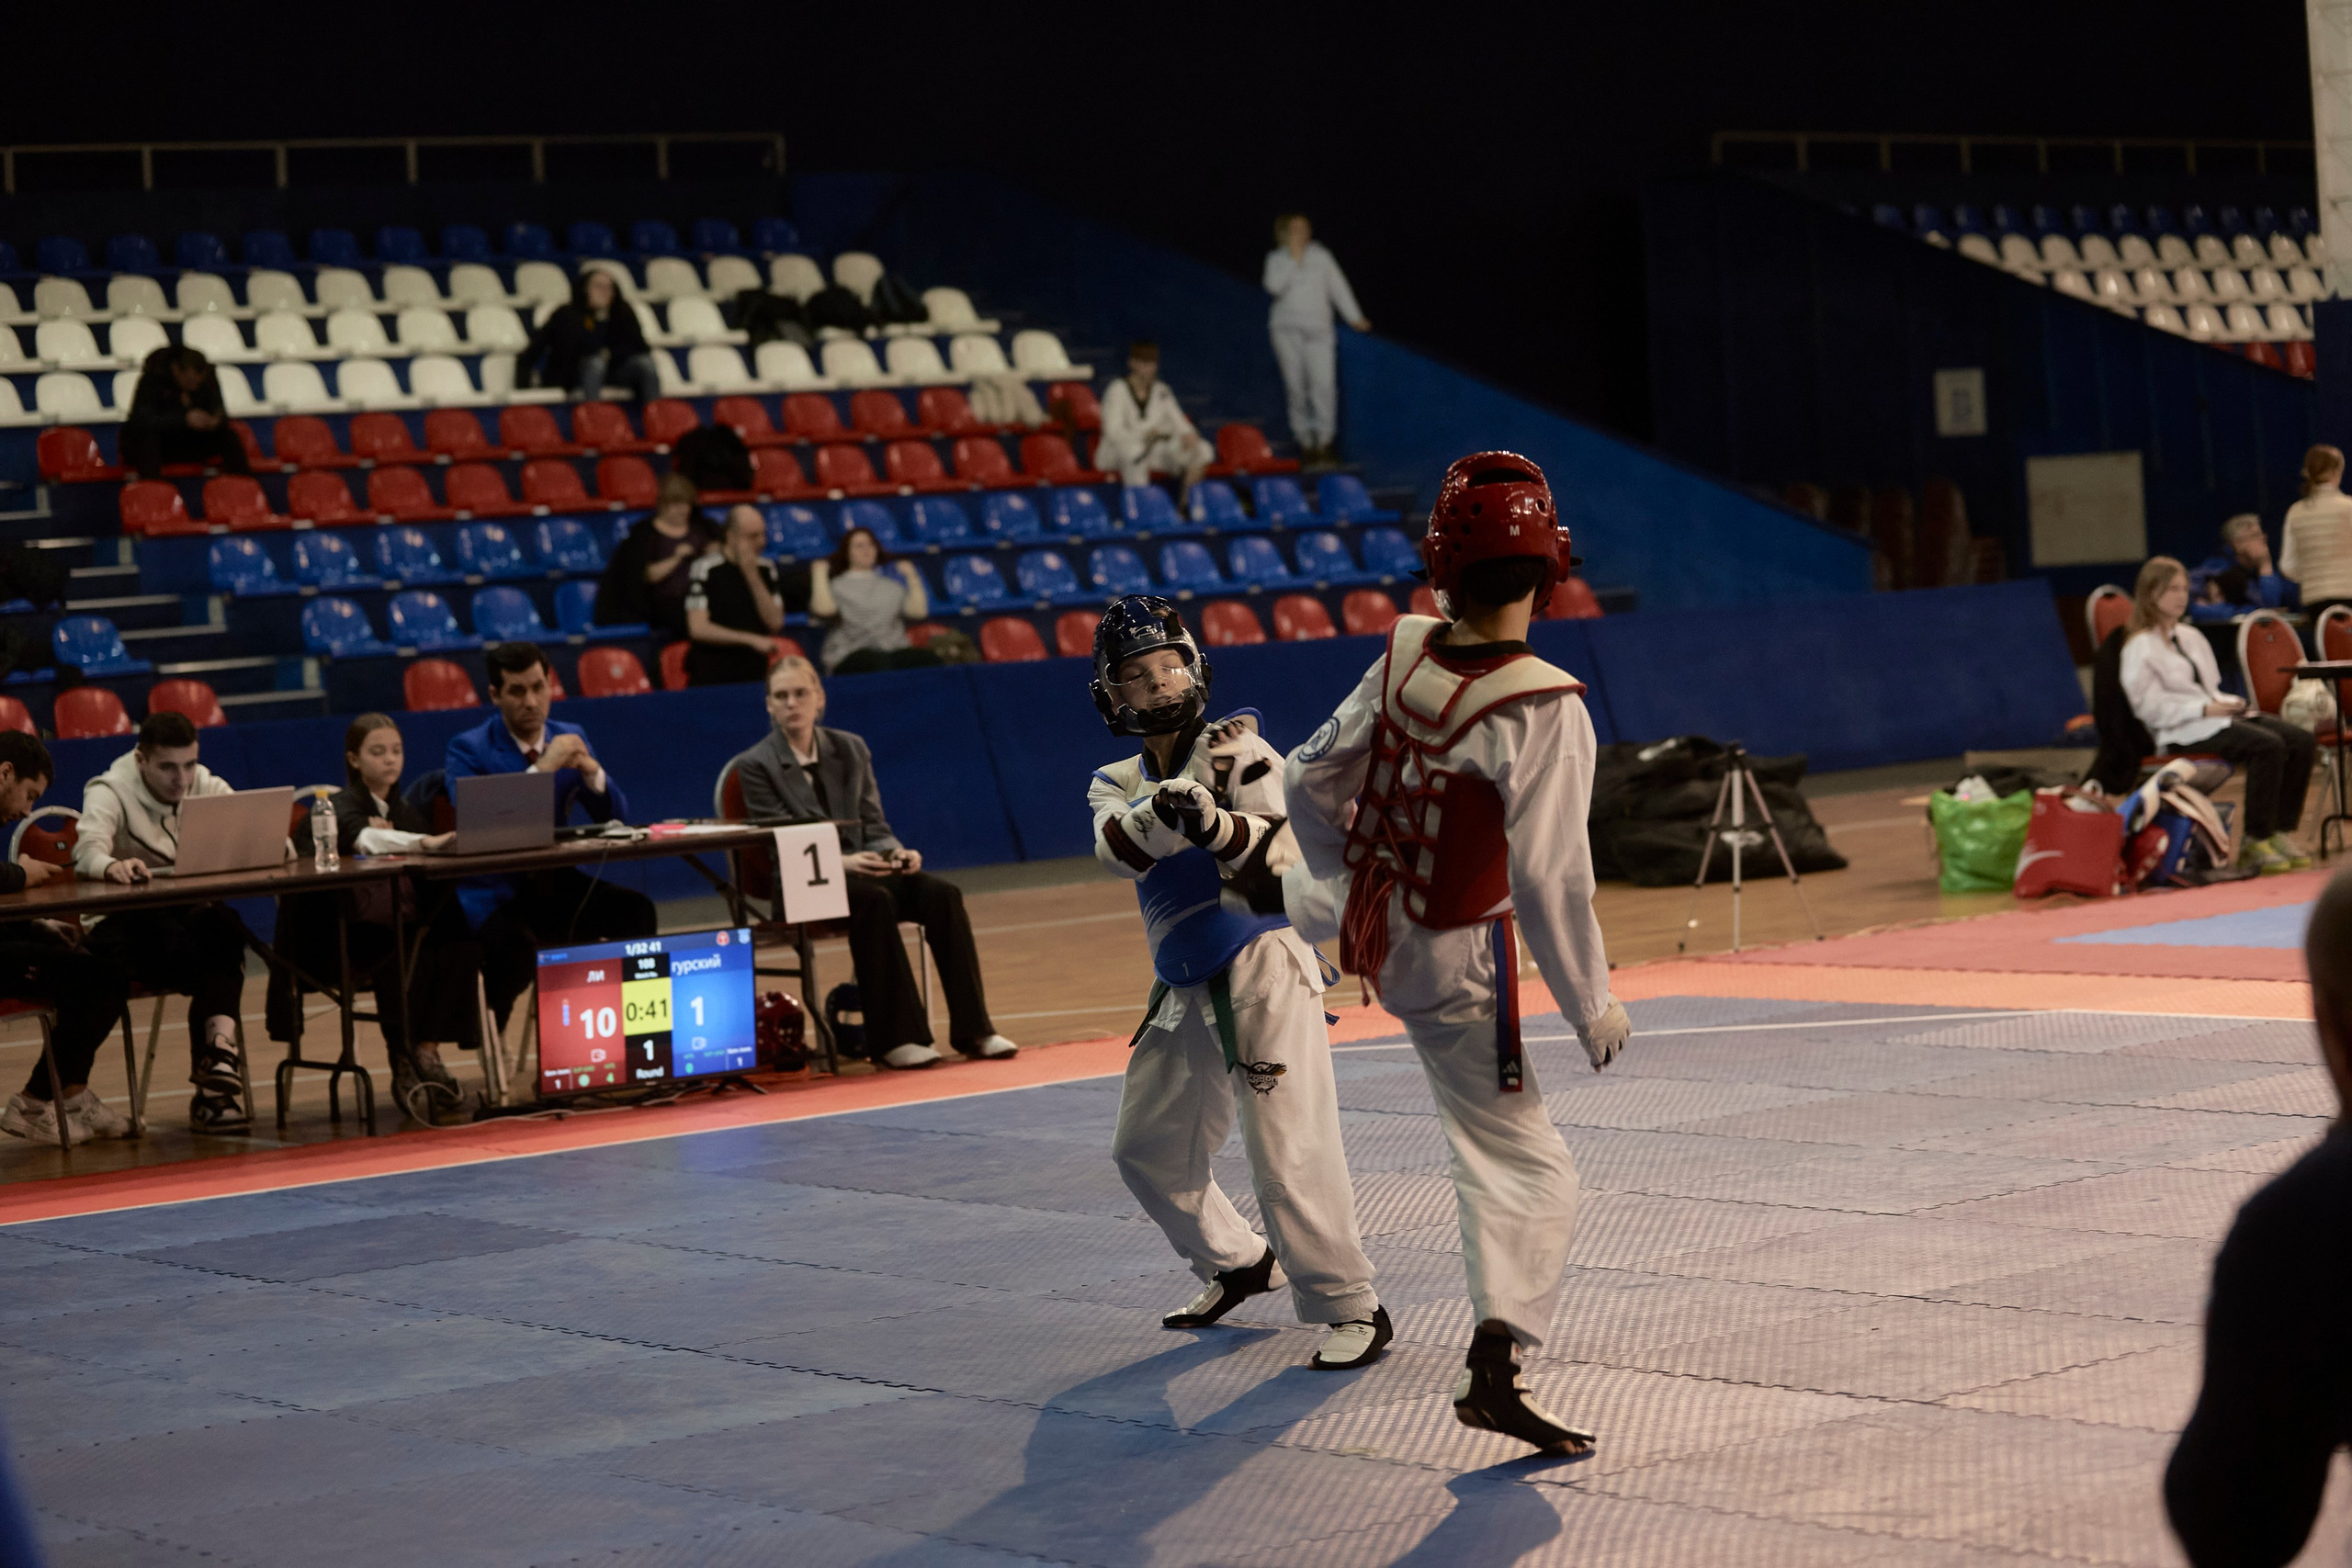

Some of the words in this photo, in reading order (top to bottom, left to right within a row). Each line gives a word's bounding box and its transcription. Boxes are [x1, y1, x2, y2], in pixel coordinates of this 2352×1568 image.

[1510, 525, 1521, 536] M
[803, 842, 830, 887] 1
[625, 942, 648, 957] 1/32
[649, 941, 662, 953] 41
[1182, 962, 1190, 977] 1
[626, 998, 668, 1021] 0:41
[690, 996, 705, 1027] 1
[580, 1007, 617, 1040] 10
[643, 1039, 655, 1061] 1
